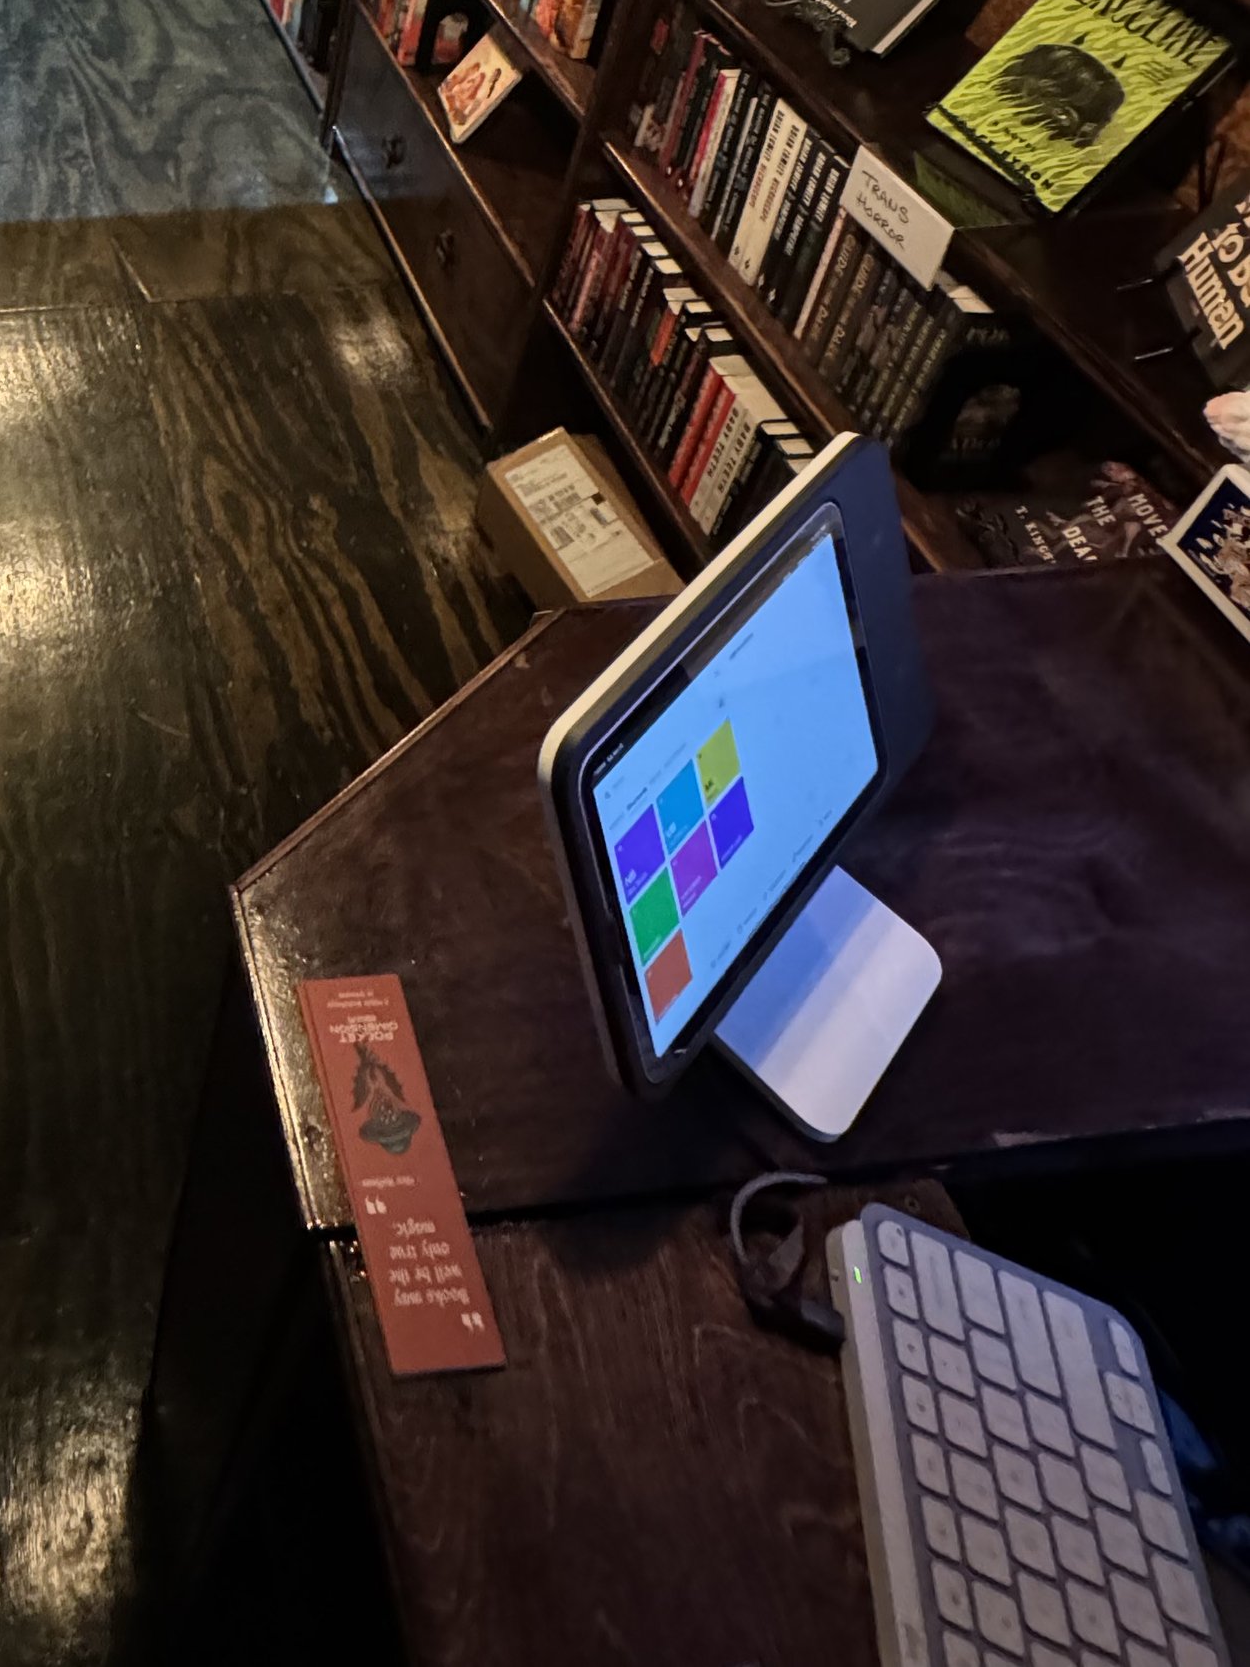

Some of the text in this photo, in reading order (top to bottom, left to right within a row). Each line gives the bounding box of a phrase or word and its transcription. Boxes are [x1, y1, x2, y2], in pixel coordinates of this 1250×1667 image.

[770, 109, 786, 133] BRIAN
[784, 124, 801, 149] BRIAN
[774, 147, 791, 177] LUMLEY
[858, 168, 911, 225] TRANS
[855, 192, 909, 250] HORROR
[704, 406, 740, 478] BABY TEETH
[714, 420, 752, 494] BABY TEETH
[1085, 492, 1116, 527] THE
